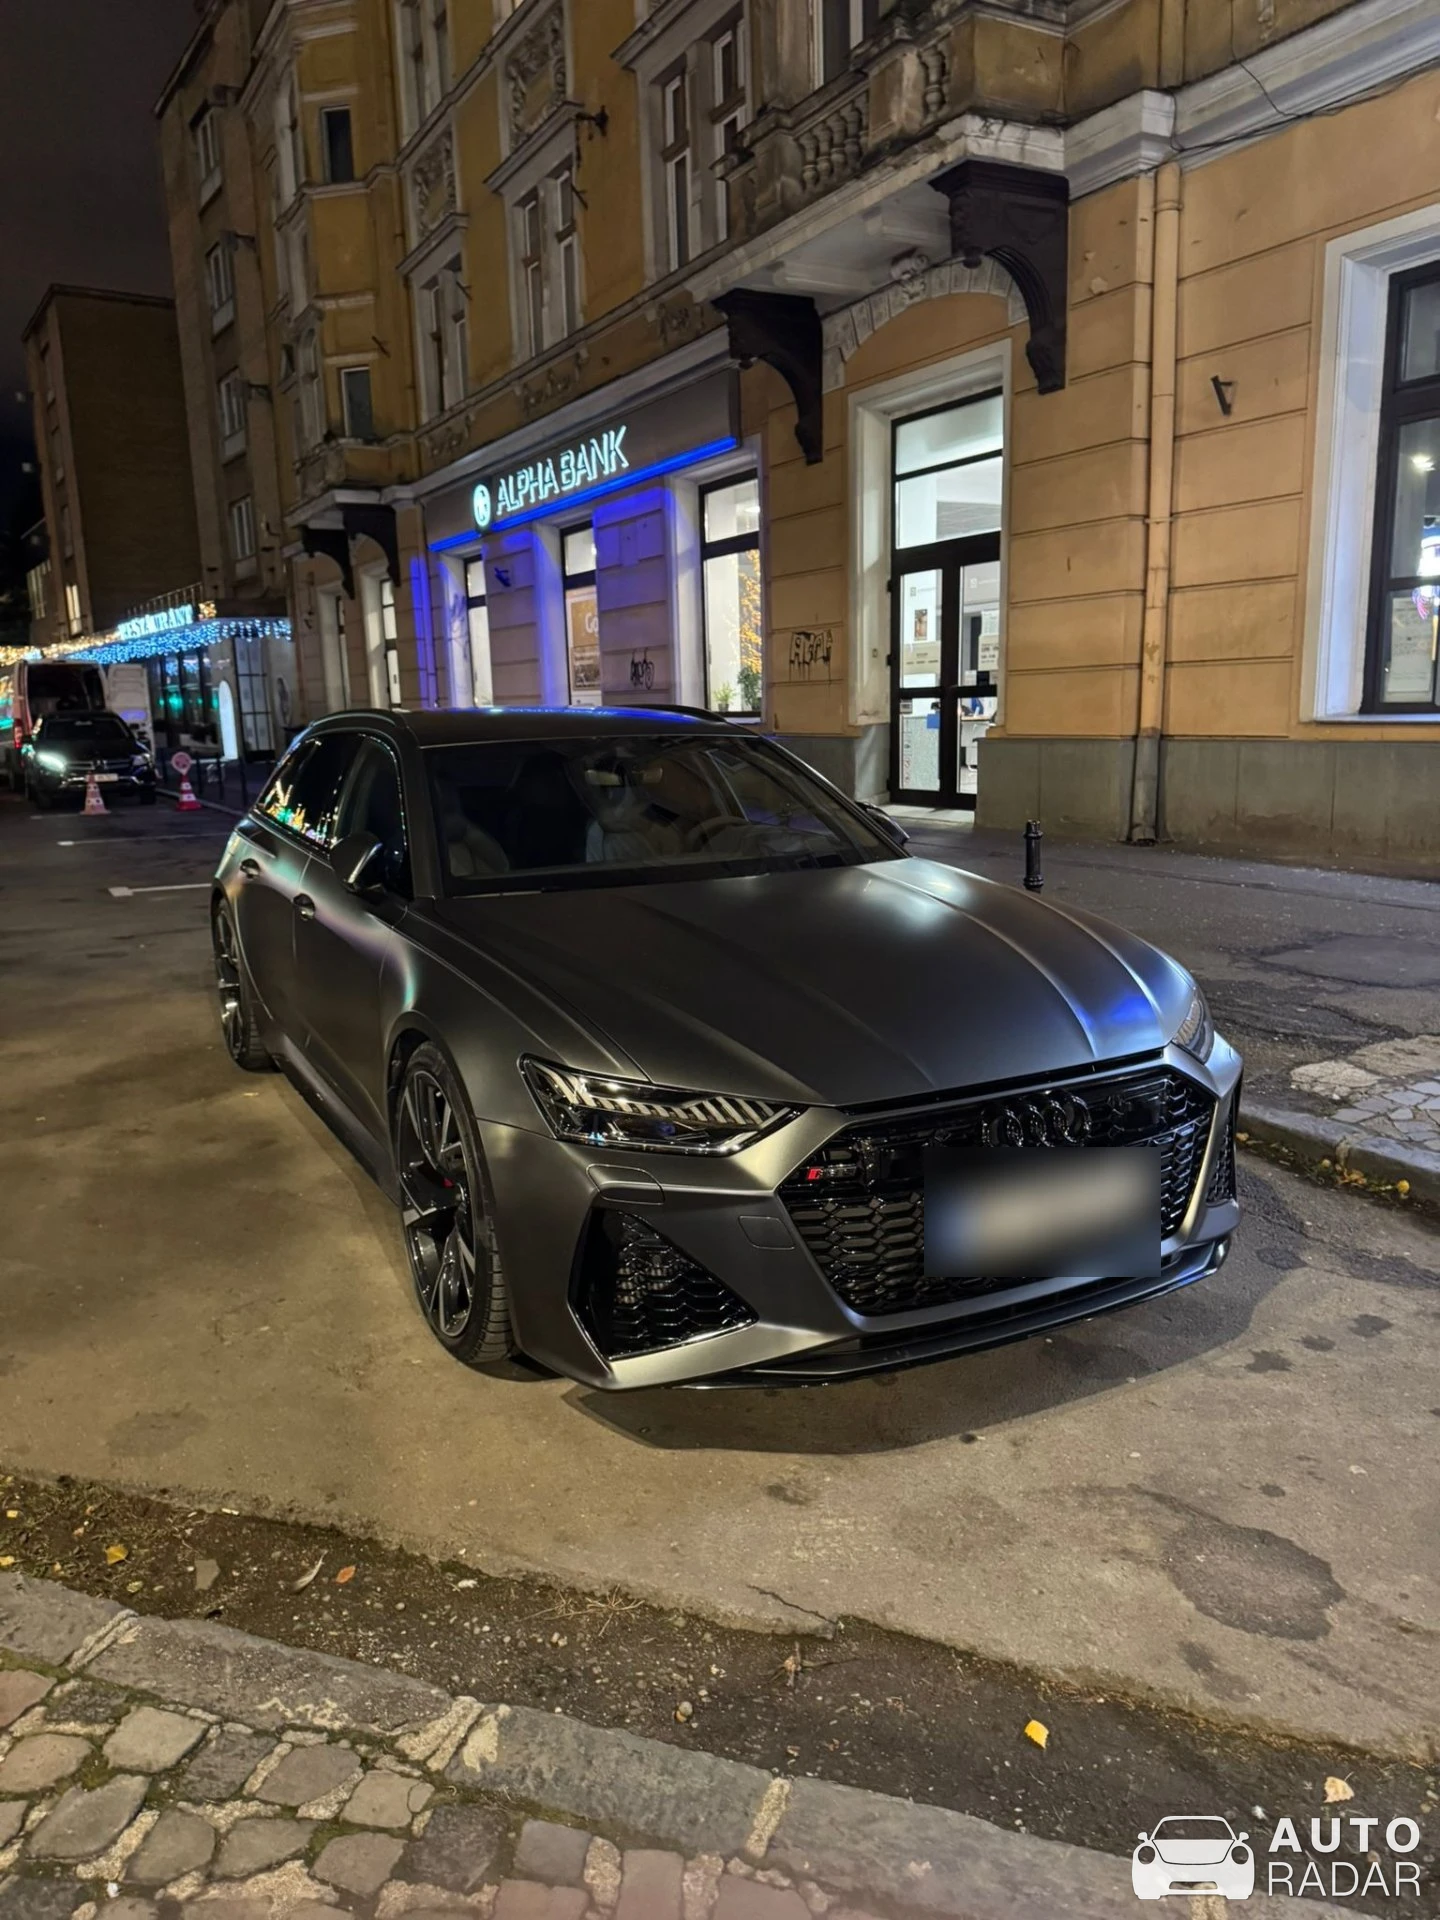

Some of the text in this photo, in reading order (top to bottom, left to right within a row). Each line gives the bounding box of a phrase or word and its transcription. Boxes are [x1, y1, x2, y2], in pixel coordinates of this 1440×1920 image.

[496, 425, 630, 516] ALPHA BANK
[117, 604, 194, 640] RESTAURANT
